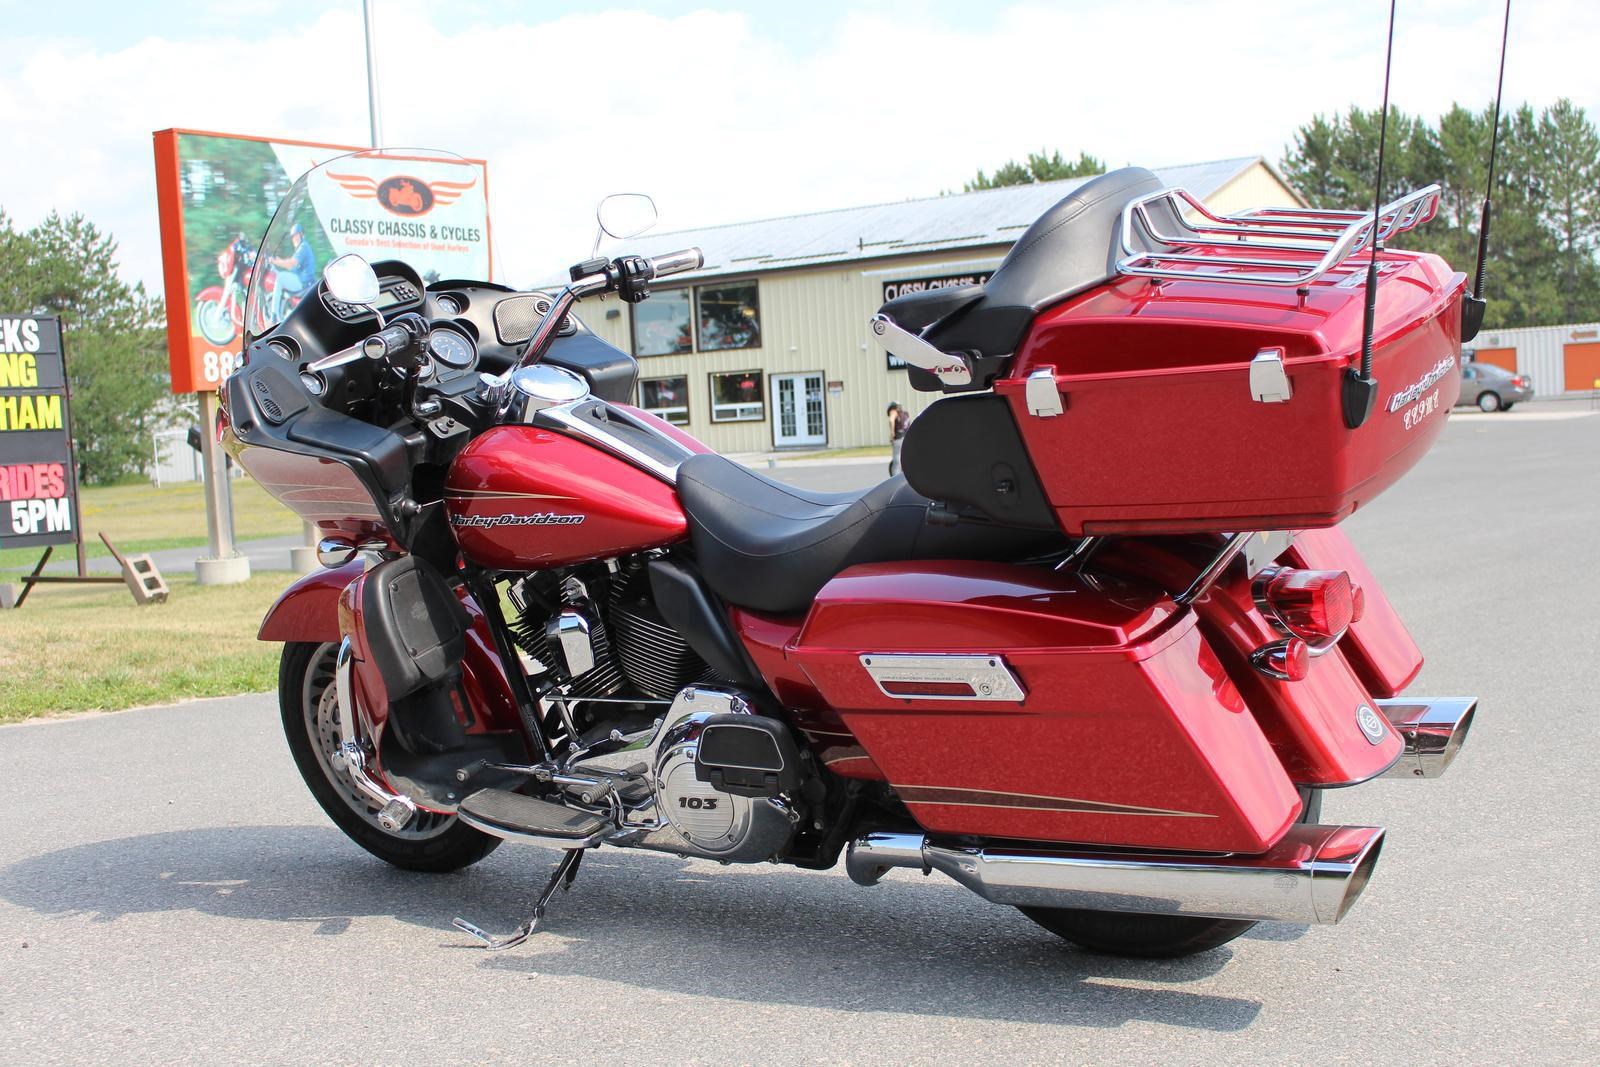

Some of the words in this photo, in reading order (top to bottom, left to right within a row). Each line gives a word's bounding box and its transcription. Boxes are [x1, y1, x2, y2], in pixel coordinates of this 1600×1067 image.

[330, 217, 374, 236] CLASSY
[377, 220, 426, 239] CHASSIS
[429, 226, 438, 240] &
[440, 225, 481, 242] CYCLES
[0, 463, 65, 501] RIDES
[11, 497, 72, 535] 5PM
[678, 796, 719, 810] 103
